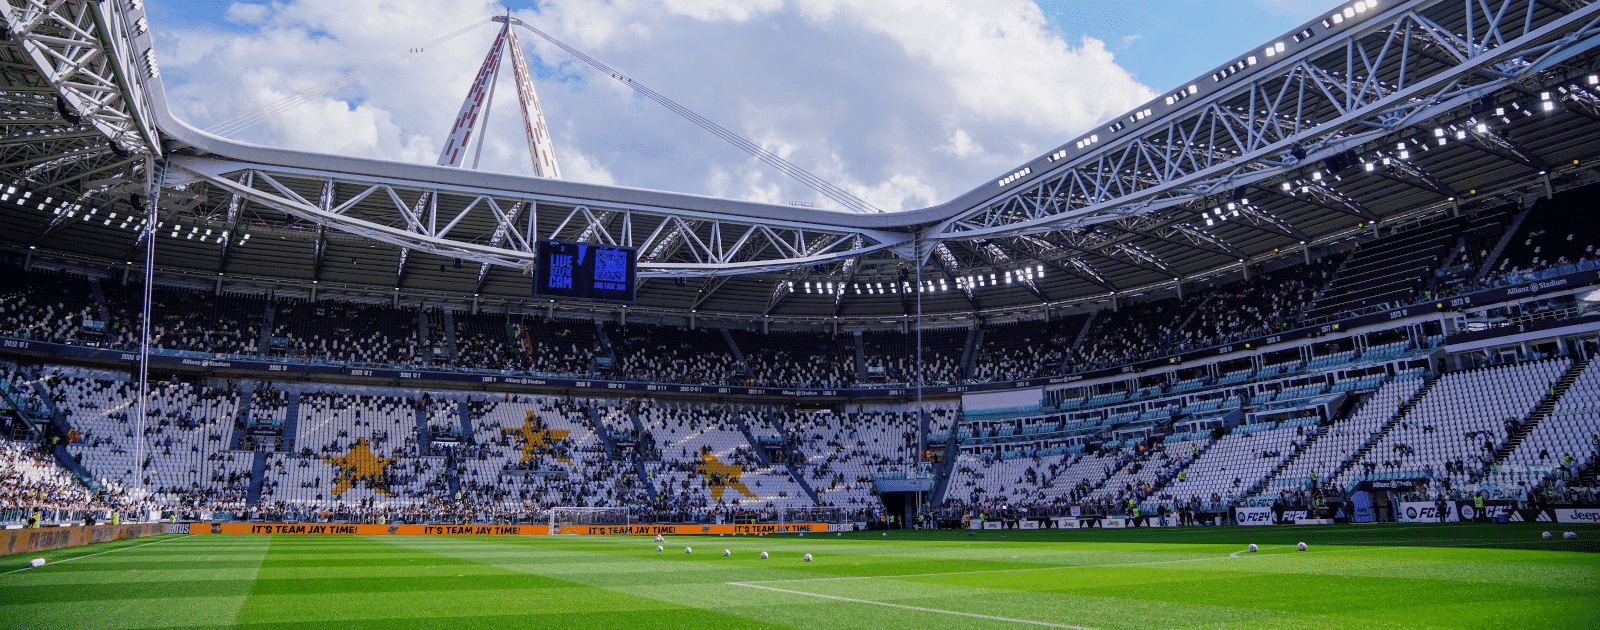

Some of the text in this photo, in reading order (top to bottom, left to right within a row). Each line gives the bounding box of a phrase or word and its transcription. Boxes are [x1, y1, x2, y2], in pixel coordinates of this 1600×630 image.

[550, 254, 573, 268] LIVE
[550, 266, 572, 276] SELFIE
[549, 276, 572, 290] CAM
[1506, 278, 1567, 296] Allianz Stadium
[1247, 512, 1270, 521] FC24
[1282, 510, 1308, 521] FC24
[1570, 510, 1600, 522] Jeep
[252, 525, 272, 533] IT'S
